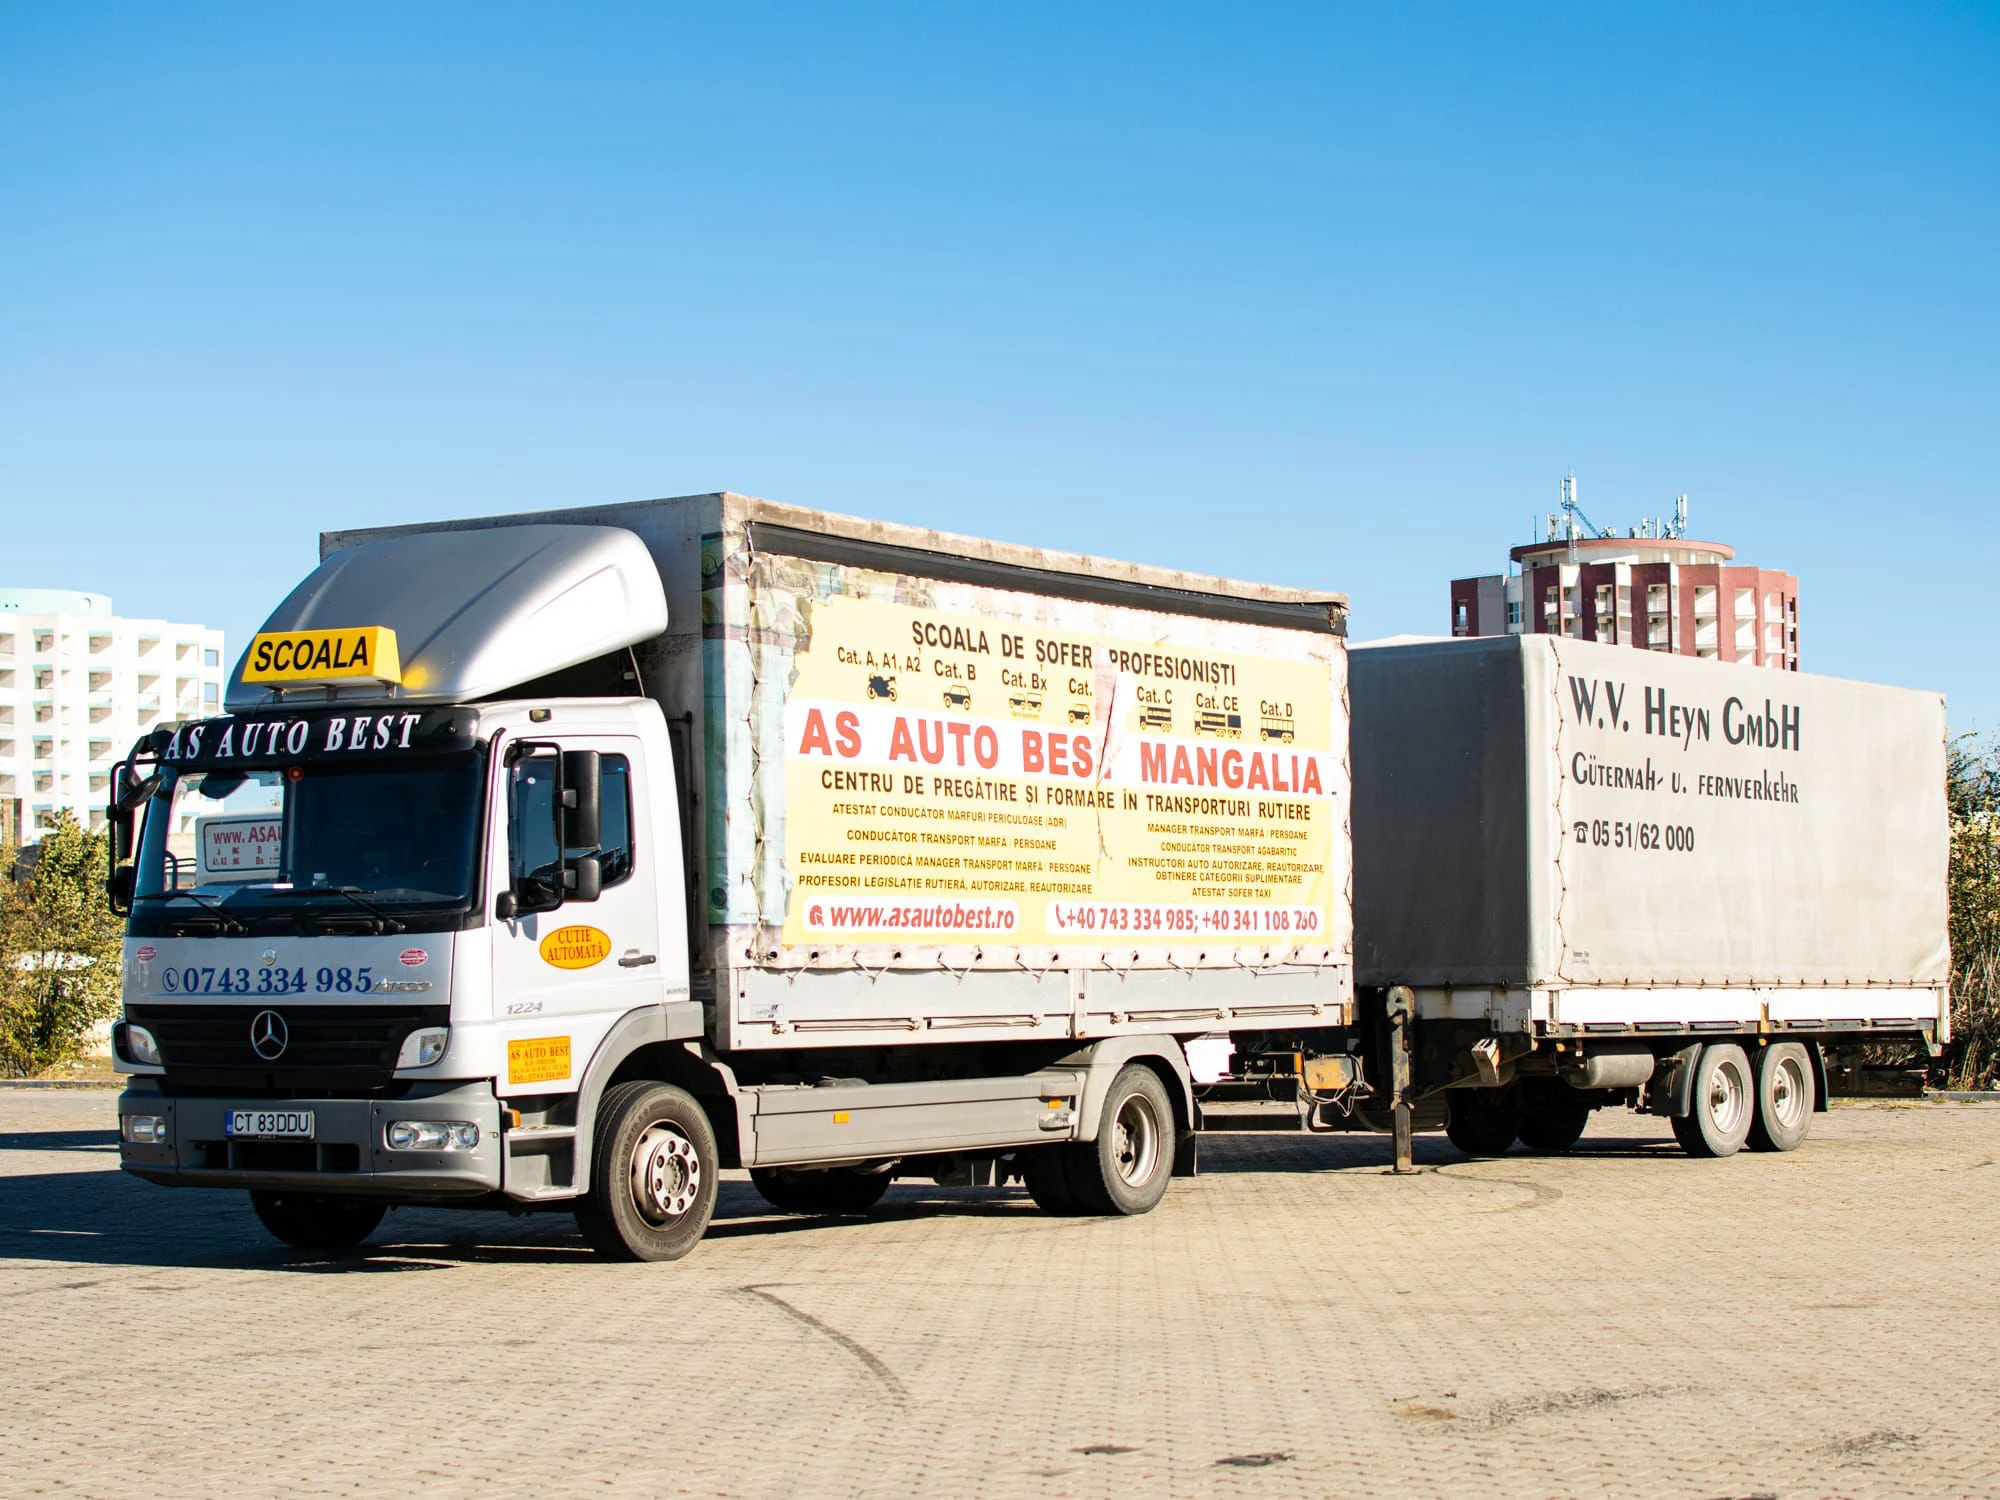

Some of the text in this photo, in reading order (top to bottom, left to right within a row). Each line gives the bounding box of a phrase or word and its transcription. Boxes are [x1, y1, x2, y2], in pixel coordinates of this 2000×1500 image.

[254, 636, 368, 672] SCOALA
[1001, 633, 1025, 660] DE
[837, 646, 921, 673] Cat. A, A1, A2
[934, 659, 977, 681] Cat. B
[1001, 668, 1048, 691] Cat. Bx
[1068, 678, 1093, 697] Cat.
[1136, 685, 1173, 705] Cat. C
[1196, 692, 1239, 713] Cat. CE
[1568, 675, 1629, 733] W.V.
[1260, 700, 1293, 718] Cat. D
[164, 713, 422, 761] AS AUTO BEST
[799, 708, 1323, 796] AS AUTO BES MANGALIA
[821, 769, 893, 793] CENTRU
[904, 775, 925, 796] DE
[934, 777, 1017, 802] PREGĂTIRE
[1047, 787, 1115, 810] FORMARE
[1123, 788, 1138, 811] ÎN
[1146, 795, 1251, 817] TRANSPORTURI
[1259, 801, 1311, 821] RUTIERE
[832, 803, 877, 816] ATESTAT
[988, 812, 1043, 826] PERICULOASE
[1045, 816, 1067, 829] (ADR)
[920, 832, 975, 846] TRANSPORT
[1014, 838, 1057, 851] PERSOANE
[1147, 823, 1188, 834] MANAGER
[1189, 825, 1236, 837] TRANSPORT
[1270, 829, 1308, 840] PERSOANE
[1665, 824, 1695, 852] 000
[1212, 843, 1256, 855] TRANSPORT
[1257, 846, 1298, 857] AGABARITIC
[800, 852, 857, 865] EVALUARE
[915, 856, 961, 869] MANAGER
[963, 858, 1013, 871] TRANSPORT
[1049, 862, 1092, 874] PERSOANE
[1128, 857, 1185, 868] INSTRUCTORI
[1188, 859, 1210, 869] AUTO
[799, 875, 861, 888] PROFESORI
[1029, 882, 1093, 895] REAUTORIZARE
[1199, 872, 1243, 883] CATEGORII
[1245, 873, 1303, 884] SUPLIMENTARE
[1192, 887, 1226, 897] ATESTAT
[1255, 889, 1272, 898] TAXI
[830, 902, 1015, 930] www.asautobest.ro
[1066, 907, 1096, 930] +40
[1100, 907, 1128, 930] 743
[1133, 908, 1161, 931] 334
[1166, 909, 1198, 934] 985;
[1202, 910, 1229, 931] +40
[1233, 909, 1258, 931] 341
[1264, 910, 1290, 931] 108
[558, 929, 592, 944] CUTIE
[183, 966, 373, 993] 0743 334 985
[506, 1001, 543, 1015] 1224
[234, 1113, 253, 1132] CT
